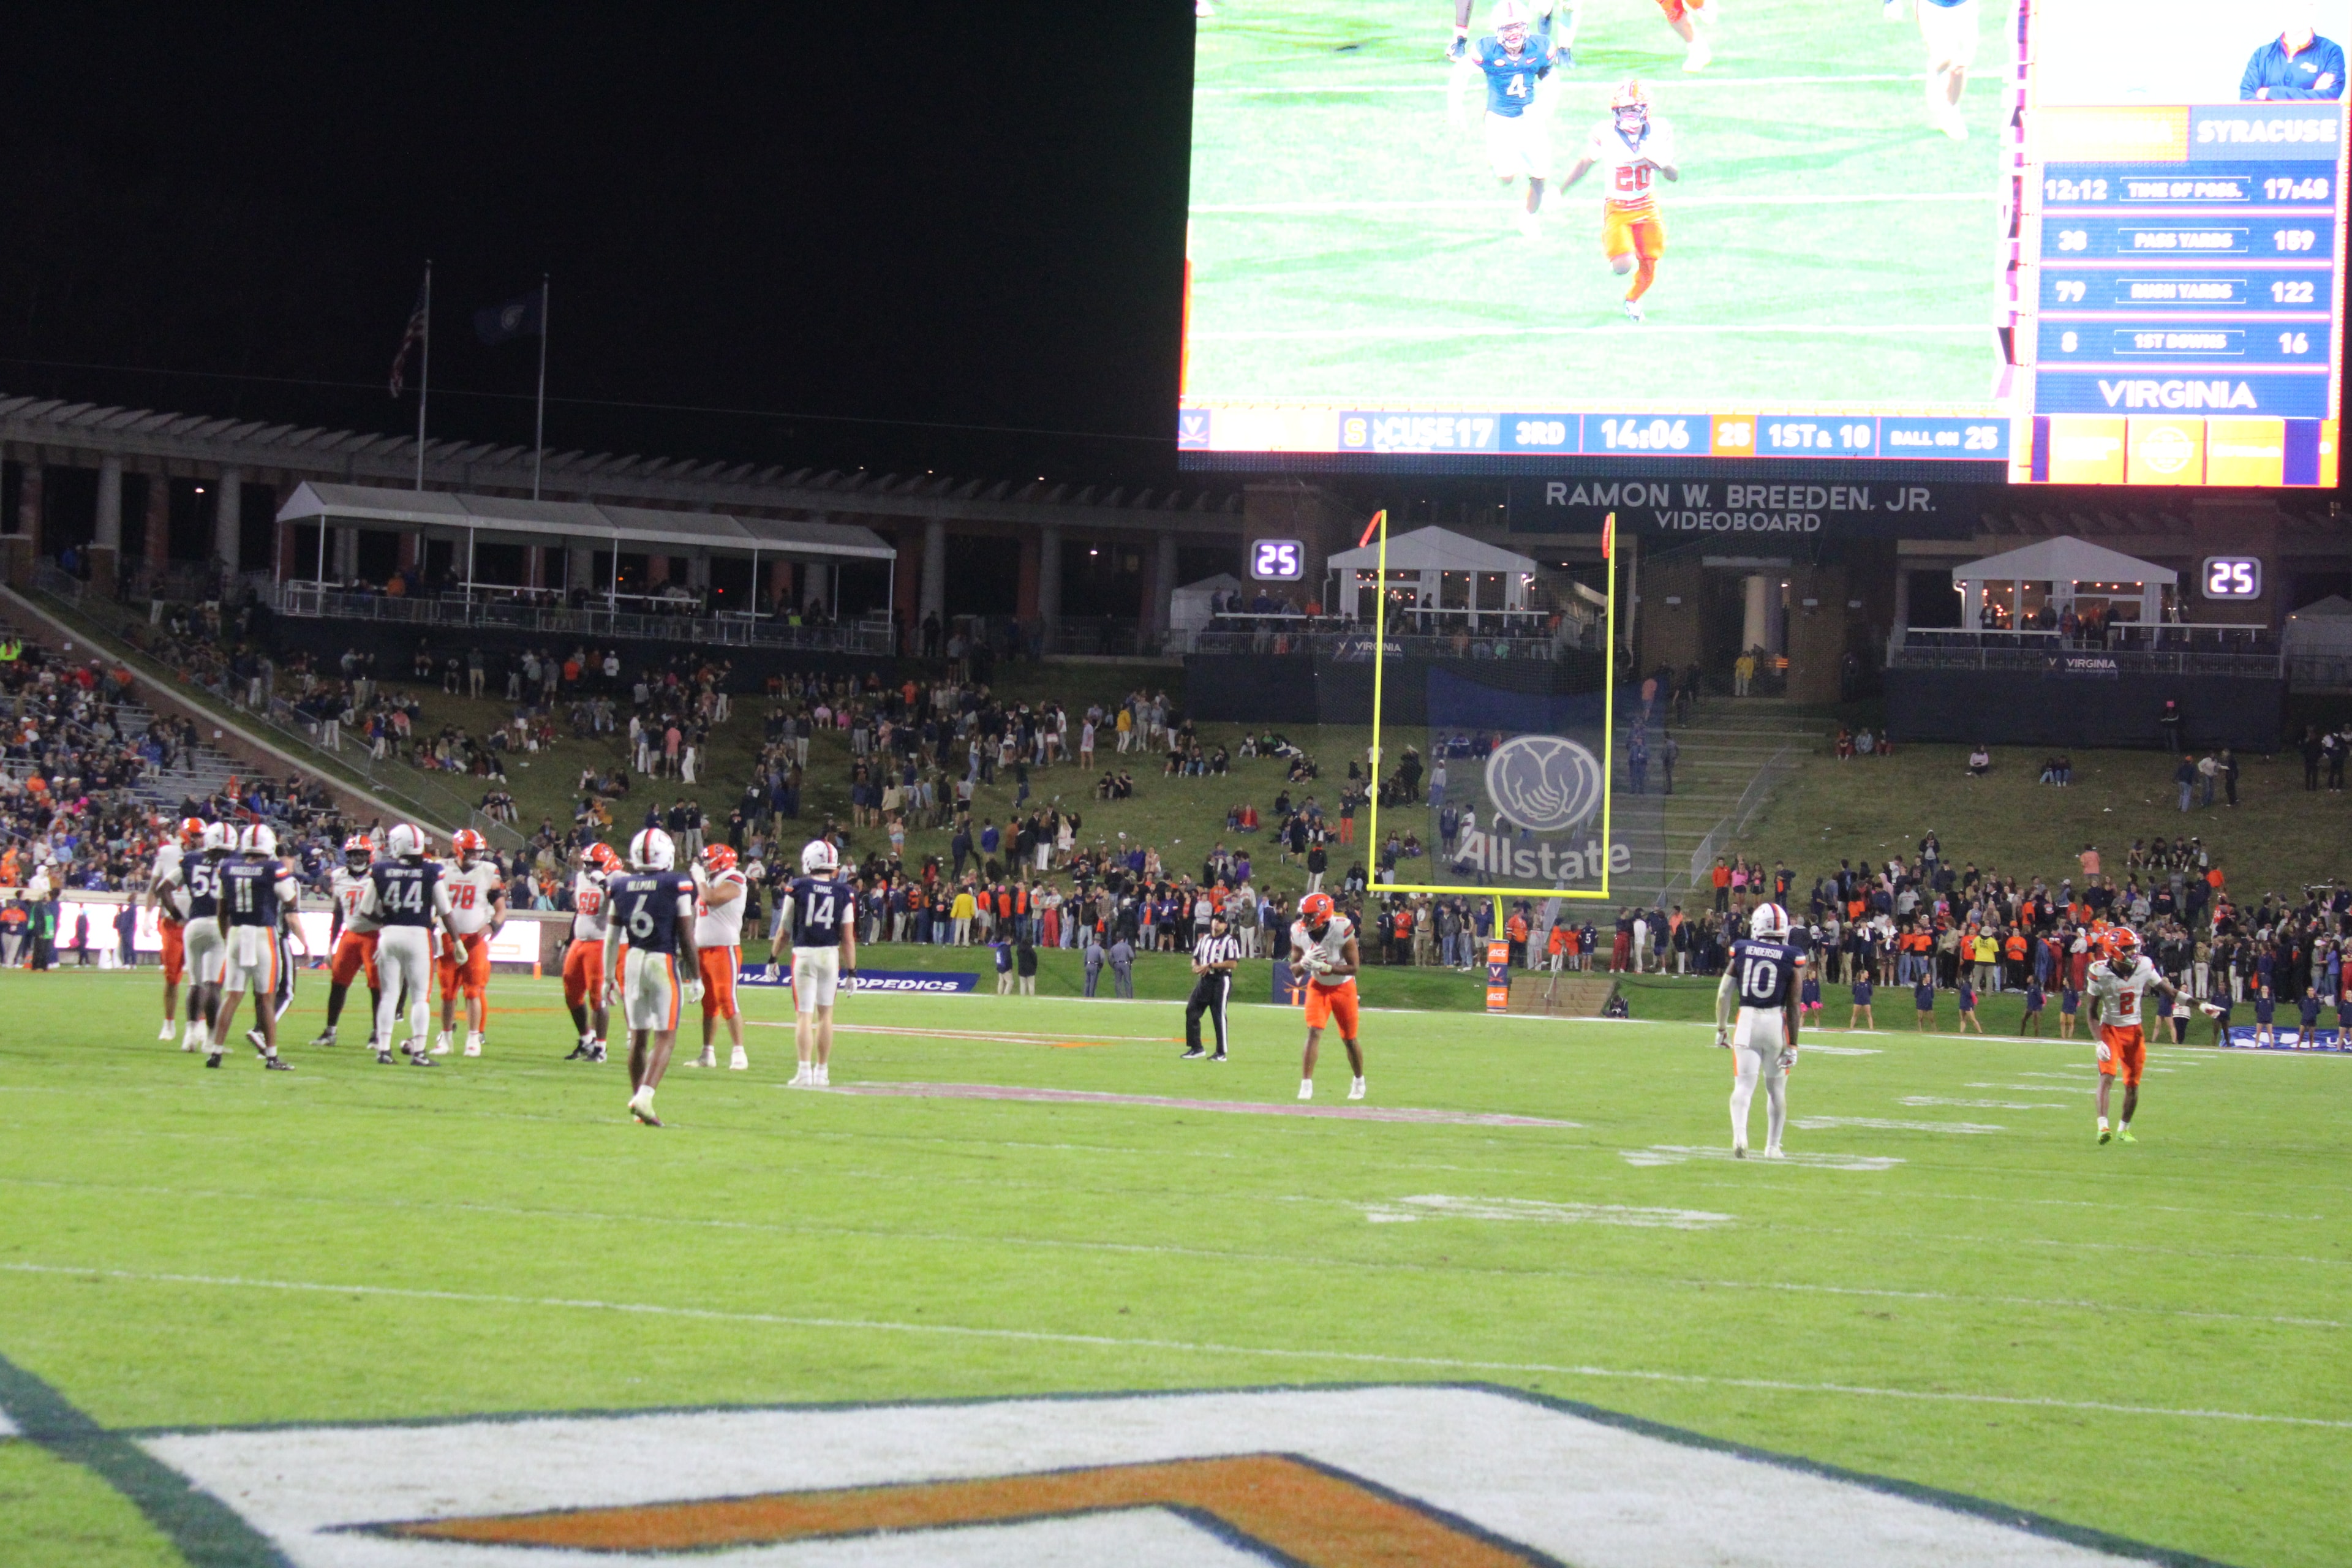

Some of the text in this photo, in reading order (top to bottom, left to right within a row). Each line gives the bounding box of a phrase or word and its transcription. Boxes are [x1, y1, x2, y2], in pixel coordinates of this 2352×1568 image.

[1506, 74, 1527, 98] 4
[2197, 120, 2337, 142] SYRACUSE
[1615, 166, 1650, 192] 20
[2045, 179, 2107, 200] 12:12
[2127, 183, 2243, 198] TIME OF POSS.
[2264, 179, 2329, 199] 17:48
[2135, 233, 2233, 249] PASS YARDS
[2274, 231, 2315, 251] 159
[2056, 282, 2086, 301] 79
[2131, 284, 2233, 299] RUSH YARDS
[2272, 282, 2314, 303] 122
[2062, 332, 2078, 352] 8
[2135, 334, 2227, 349] 1ST DOWNS
[2279, 333, 2309, 353] 16
[2098, 380, 2258, 409] VIRGINIA
[1455, 419, 1494, 448] 17
[1516, 421, 1566, 445] 3RD
[1600, 420, 1689, 449] 14:06
[1840, 425, 1871, 449] 10
[1891, 427, 1998, 450] BALL ON 25
[1546, 481, 1669, 508] RAMON
[1682, 485, 1711, 508] W.
[1886, 488, 1936, 512] JR.
[1655, 510, 1821, 532] VIDEOBOARD
[1258, 546, 1296, 576] 25
[2210, 563, 2253, 593] 25
[2066, 658, 2116, 668] VIRGINIA
[1454, 832, 1631, 880] Allstate
[236, 878, 253, 913] 11
[383, 881, 423, 914] 44
[448, 884, 476, 910] 78
[630, 894, 654, 938] 6
[805, 892, 835, 930] 14
[1745, 945, 1784, 960] HENDERSON
[1742, 957, 1778, 998] 10
[2120, 992, 2135, 1016] 2
